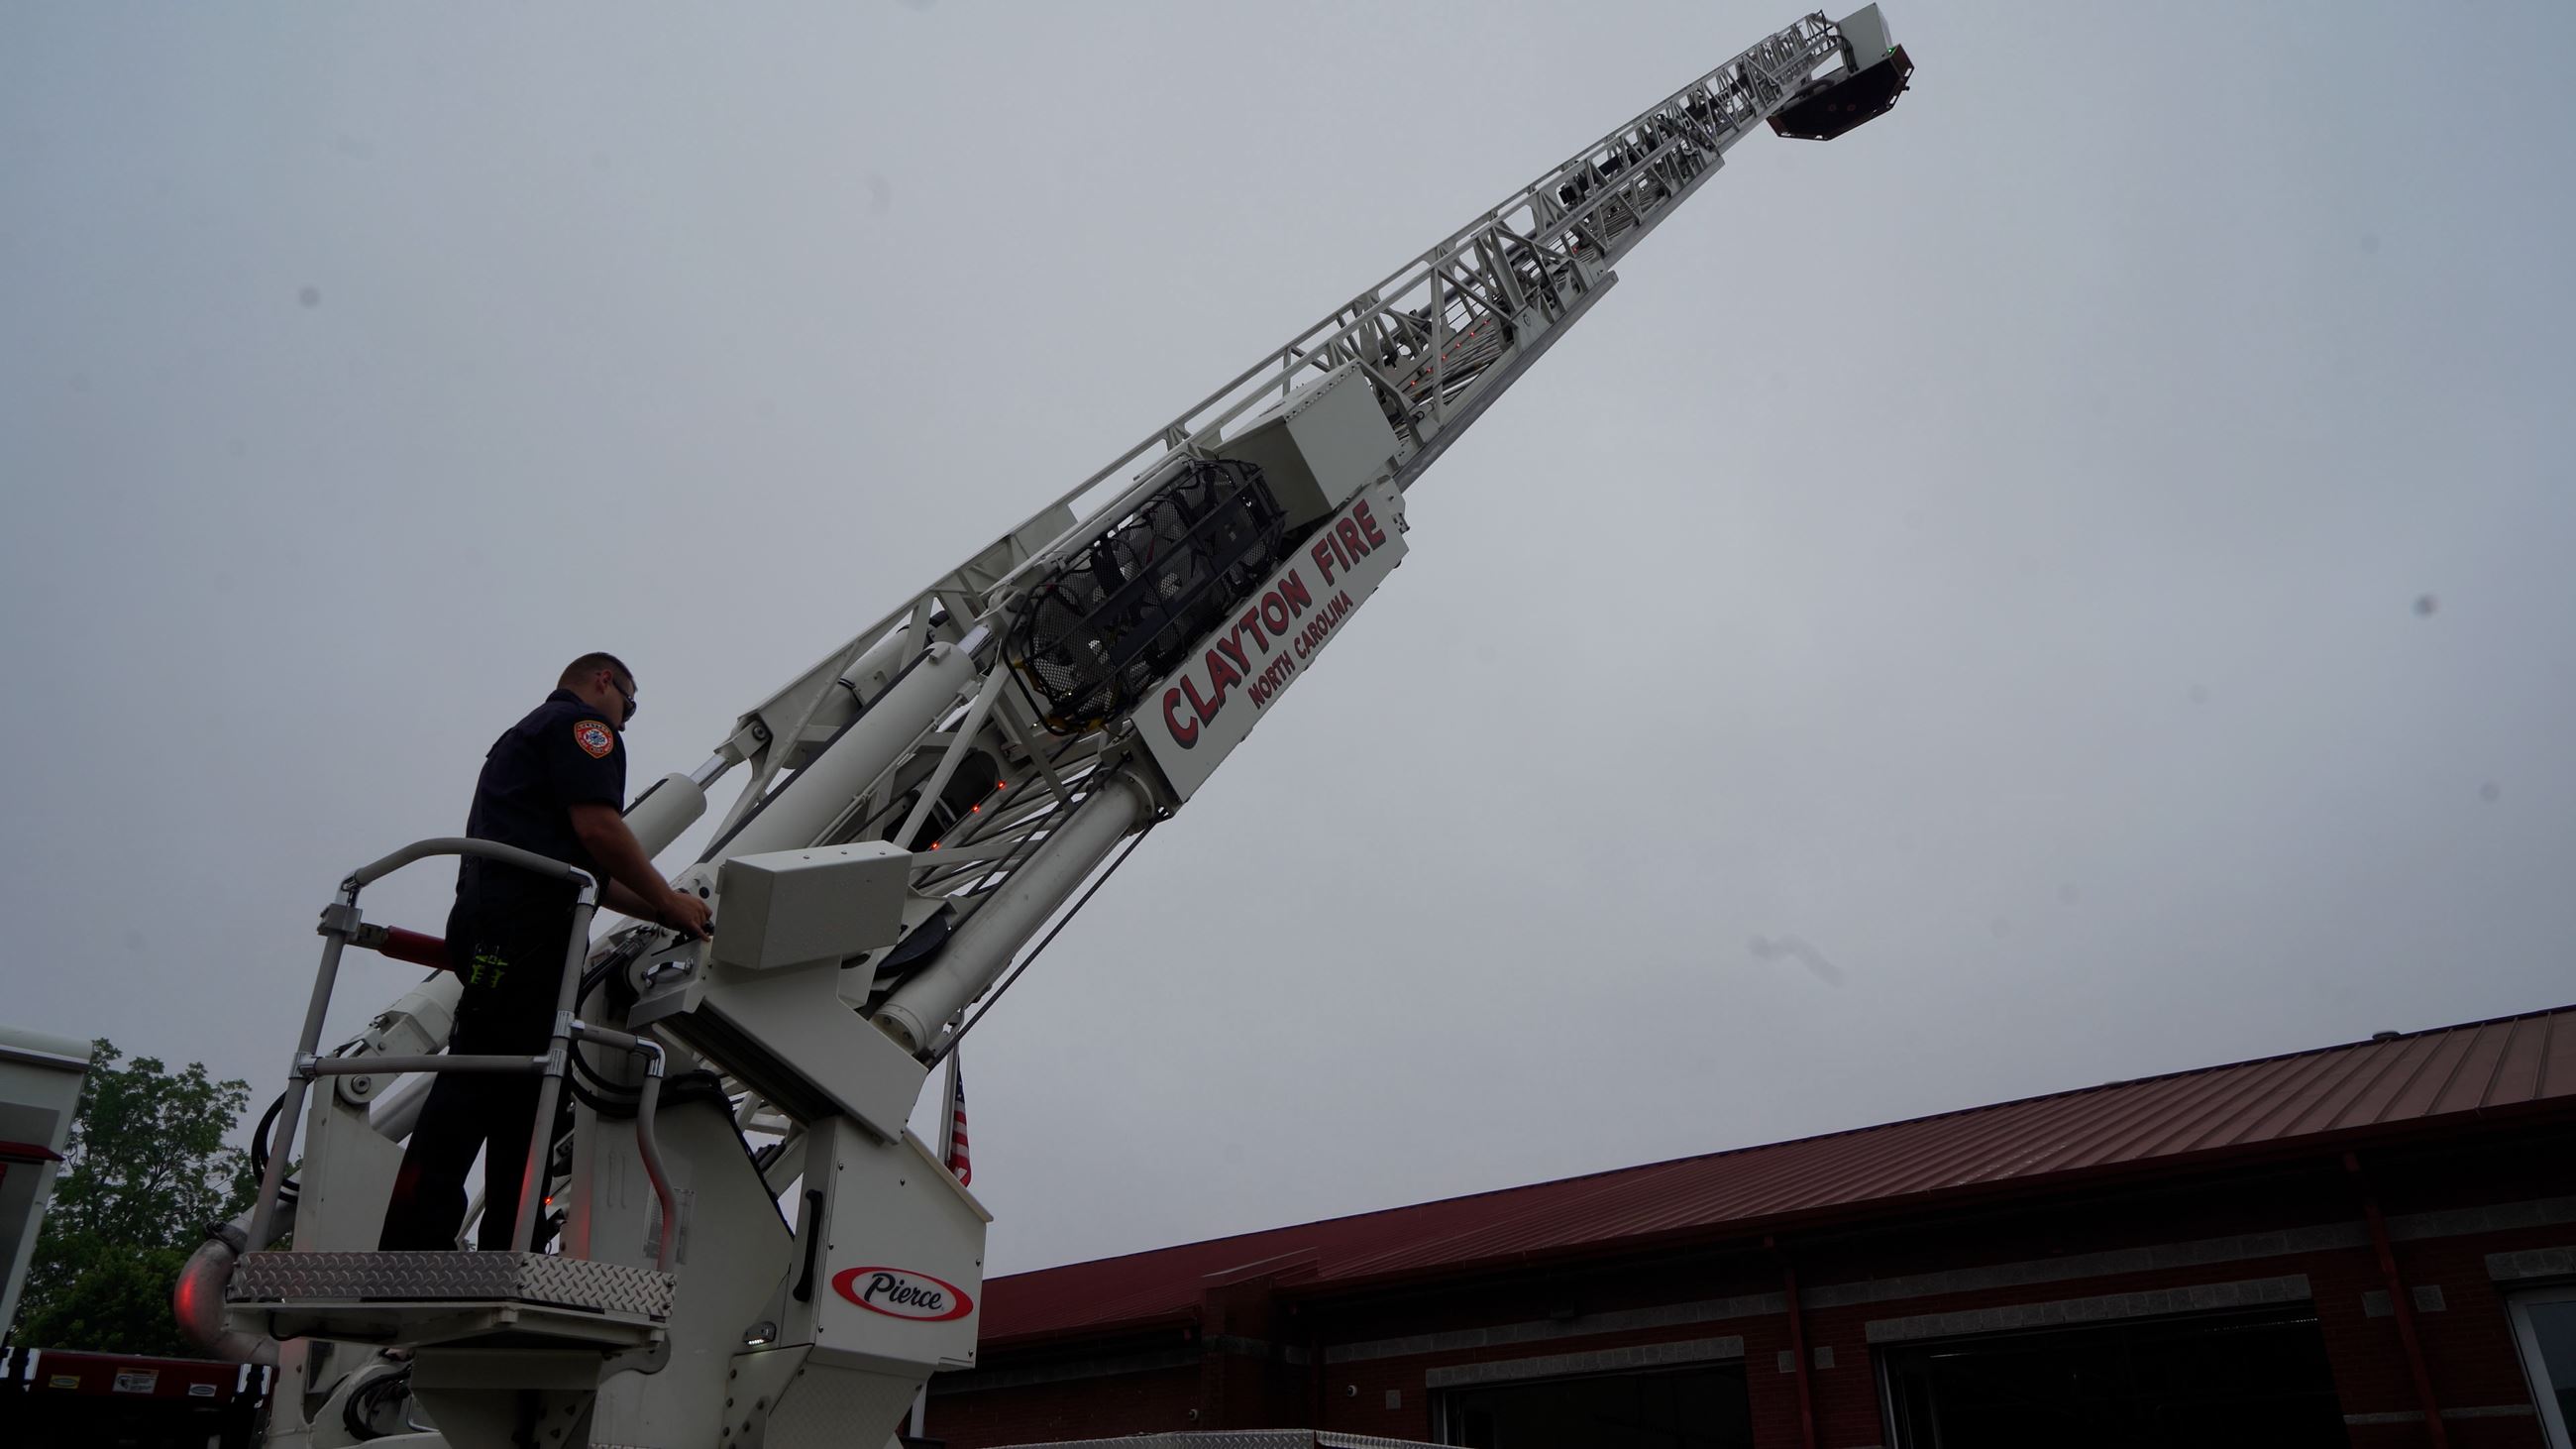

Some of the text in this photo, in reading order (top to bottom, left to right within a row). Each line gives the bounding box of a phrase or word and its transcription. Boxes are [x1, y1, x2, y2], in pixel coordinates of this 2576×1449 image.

[1163, 500, 1386, 749] CLAYTON FIRE
[1247, 590, 1353, 710] NORTH CAROLINA
[864, 1273, 942, 1309] Pierce
